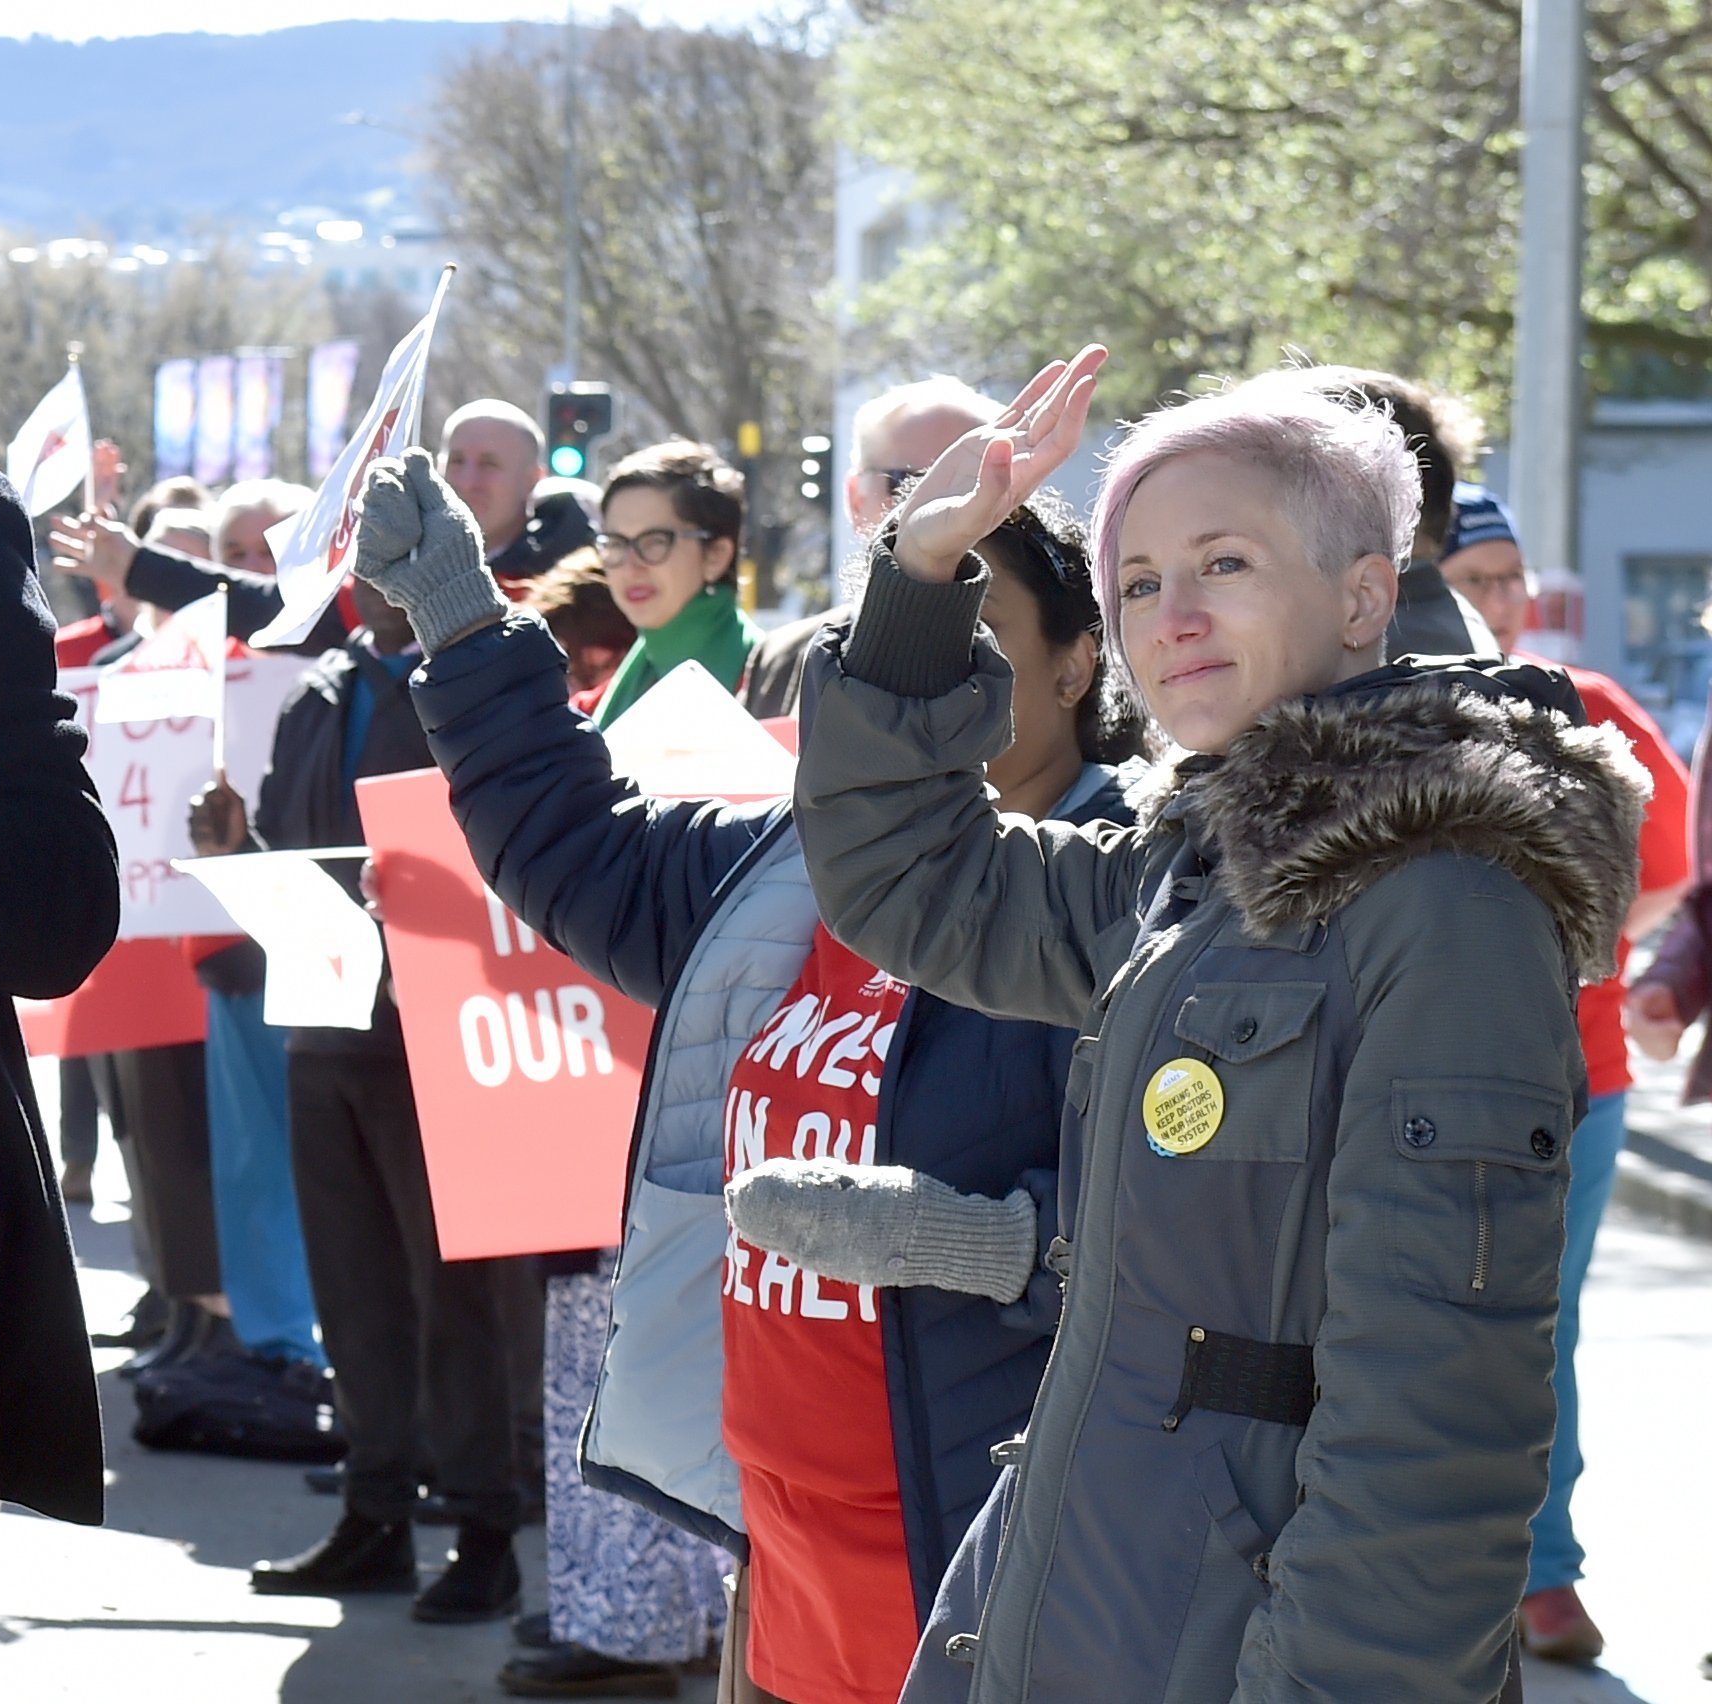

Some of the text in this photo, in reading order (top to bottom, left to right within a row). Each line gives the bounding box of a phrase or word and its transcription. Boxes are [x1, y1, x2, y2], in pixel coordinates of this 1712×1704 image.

[119, 762, 150, 828] 4
[483, 880, 536, 957] I
[459, 983, 614, 1088] OUR
[745, 993, 898, 1097] INVES
[1154, 1080, 1204, 1117] STRIKING TO
[1156, 1089, 1212, 1130] KEEP DOCTORS
[1160, 1101, 1218, 1140] IN OUR HEALTH
[792, 1111, 876, 1165] OU
[1177, 1120, 1210, 1146] SYSTEM
